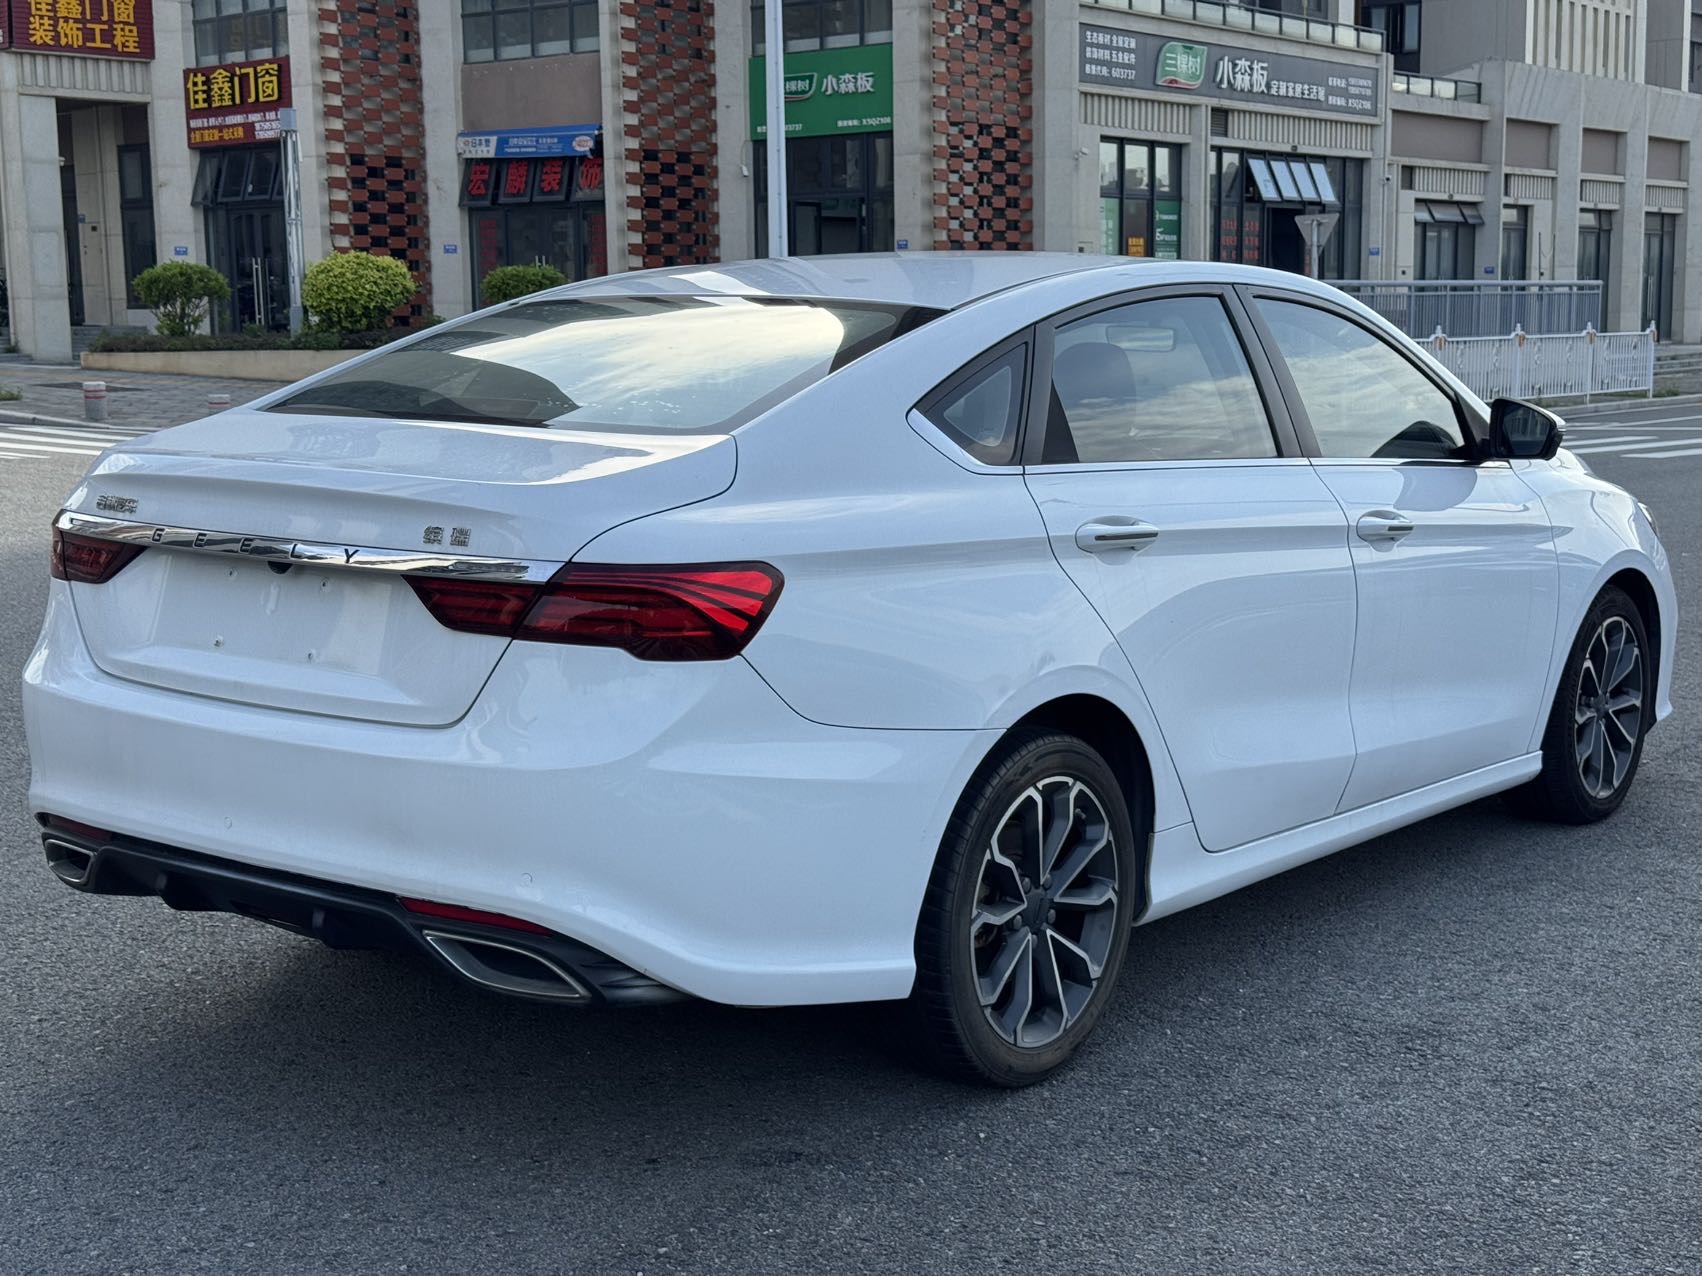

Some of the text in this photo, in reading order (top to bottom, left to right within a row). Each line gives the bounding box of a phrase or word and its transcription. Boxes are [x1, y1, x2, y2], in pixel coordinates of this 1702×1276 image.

[29, 16, 140, 53] 装饰工程
[1165, 52, 1201, 75] 三棵树
[1216, 55, 1269, 95] 小森板
[187, 63, 279, 110] 佳鑫门窗
[784, 79, 809, 93] 棵树
[821, 72, 875, 96] 小森板
[152, 527, 360, 565] GEELY
